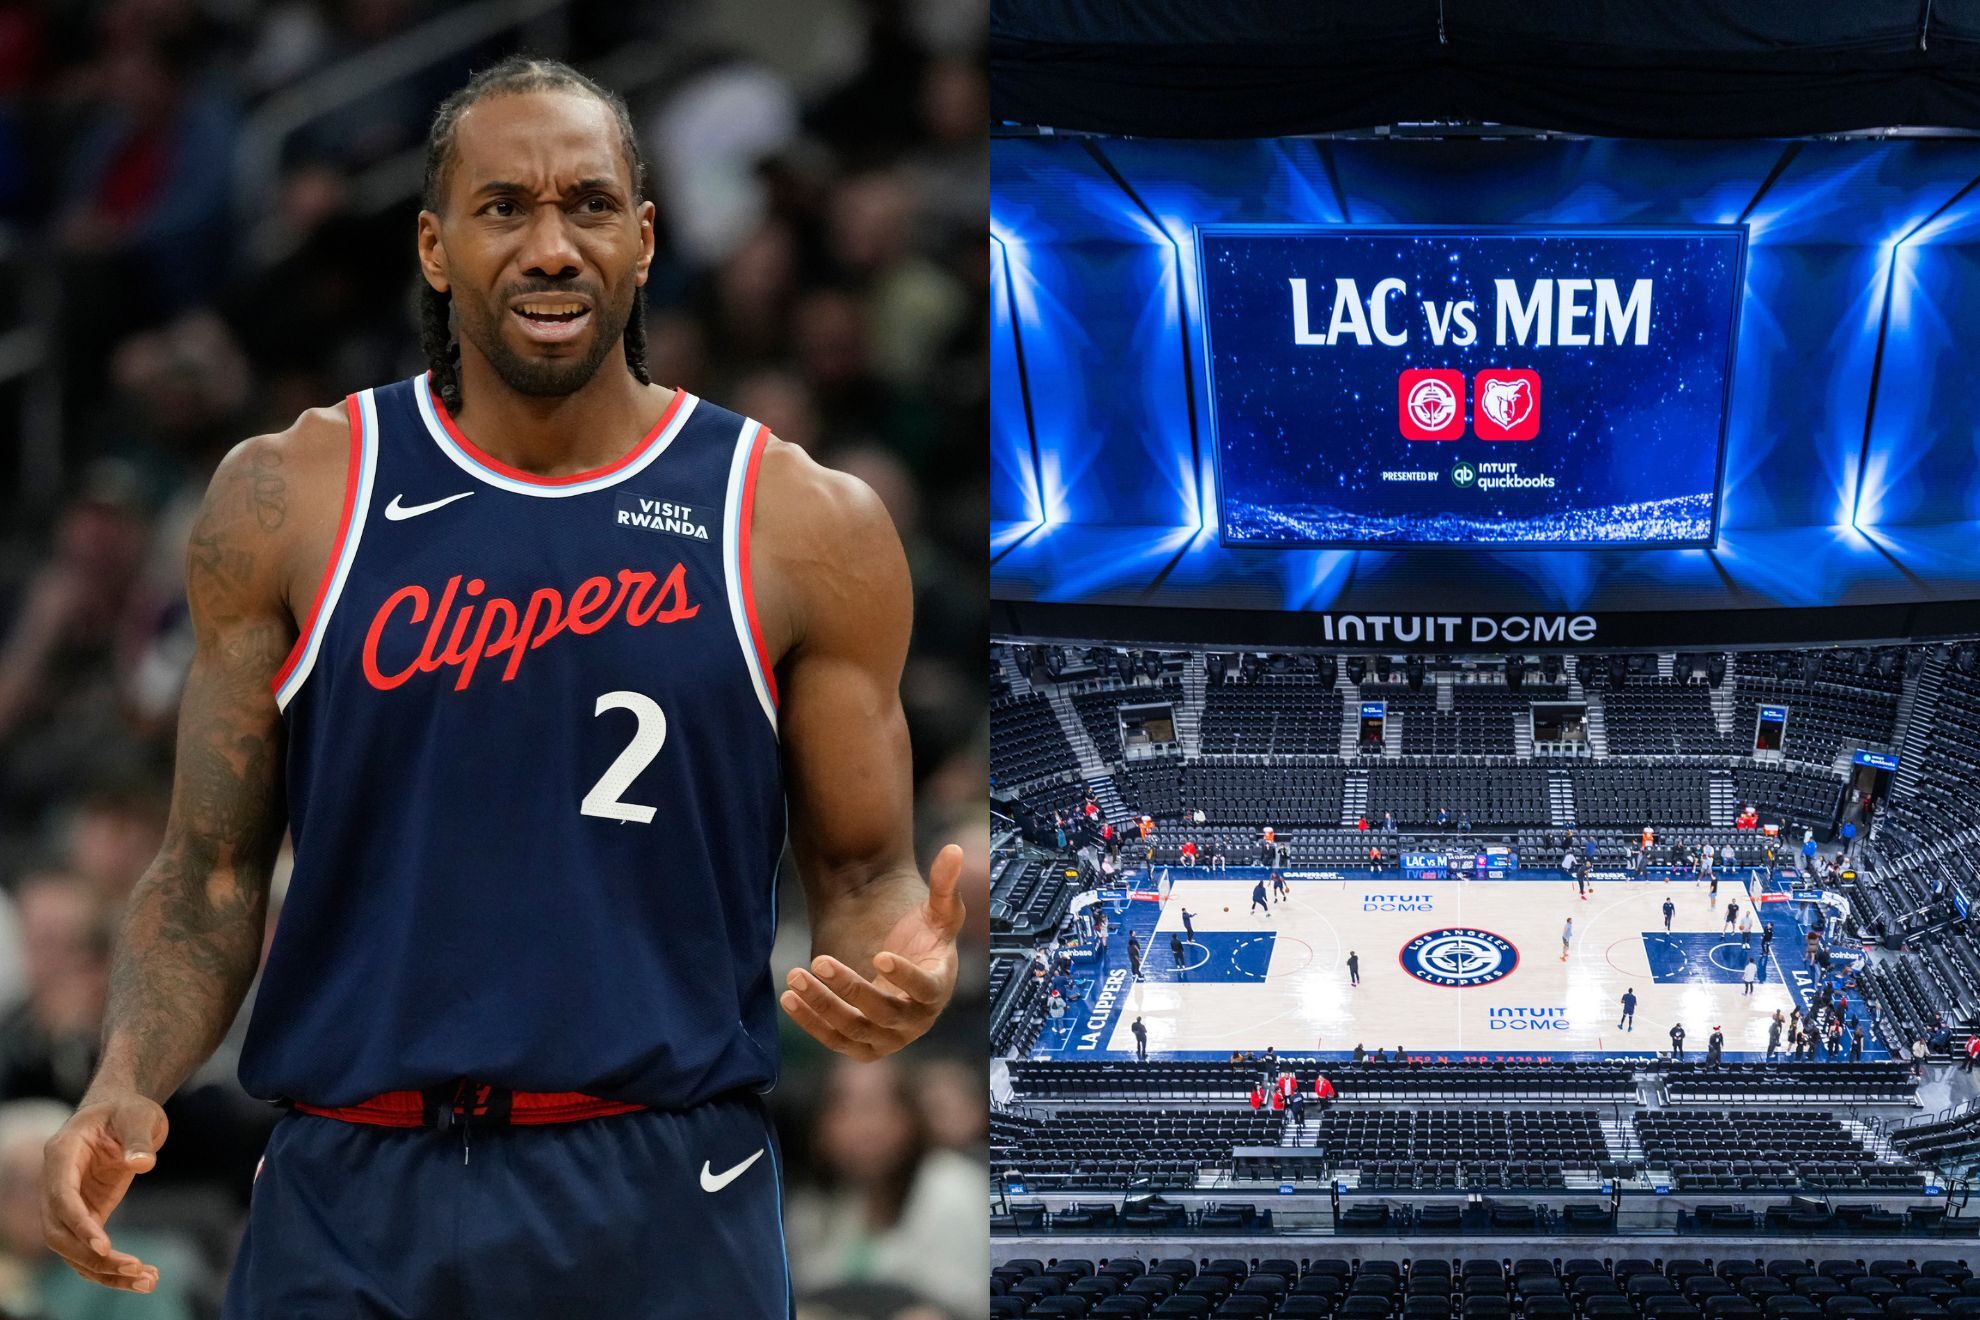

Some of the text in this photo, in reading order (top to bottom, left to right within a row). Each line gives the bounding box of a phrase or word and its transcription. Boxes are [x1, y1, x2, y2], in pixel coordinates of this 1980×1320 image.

[1289, 277, 1408, 346] LAC
[1494, 278, 1653, 346] MEM
[1382, 471, 1439, 481] PRESENTED BY
[1478, 474, 1555, 492] quickbooks
[640, 498, 692, 521] VISIT
[617, 510, 709, 540] RWANDA
[362, 562, 700, 692] Clippers
[1323, 615, 1462, 642] INTUIT
[580, 690, 667, 824] 2
[1406, 856, 1425, 867] LAC
[1408, 929, 1510, 952] LOS ANGELES
[1416, 969, 1503, 986] CLIPPERS
[1791, 970, 1813, 987] LA
[1076, 968, 1127, 1051] LA CLIPPERS
